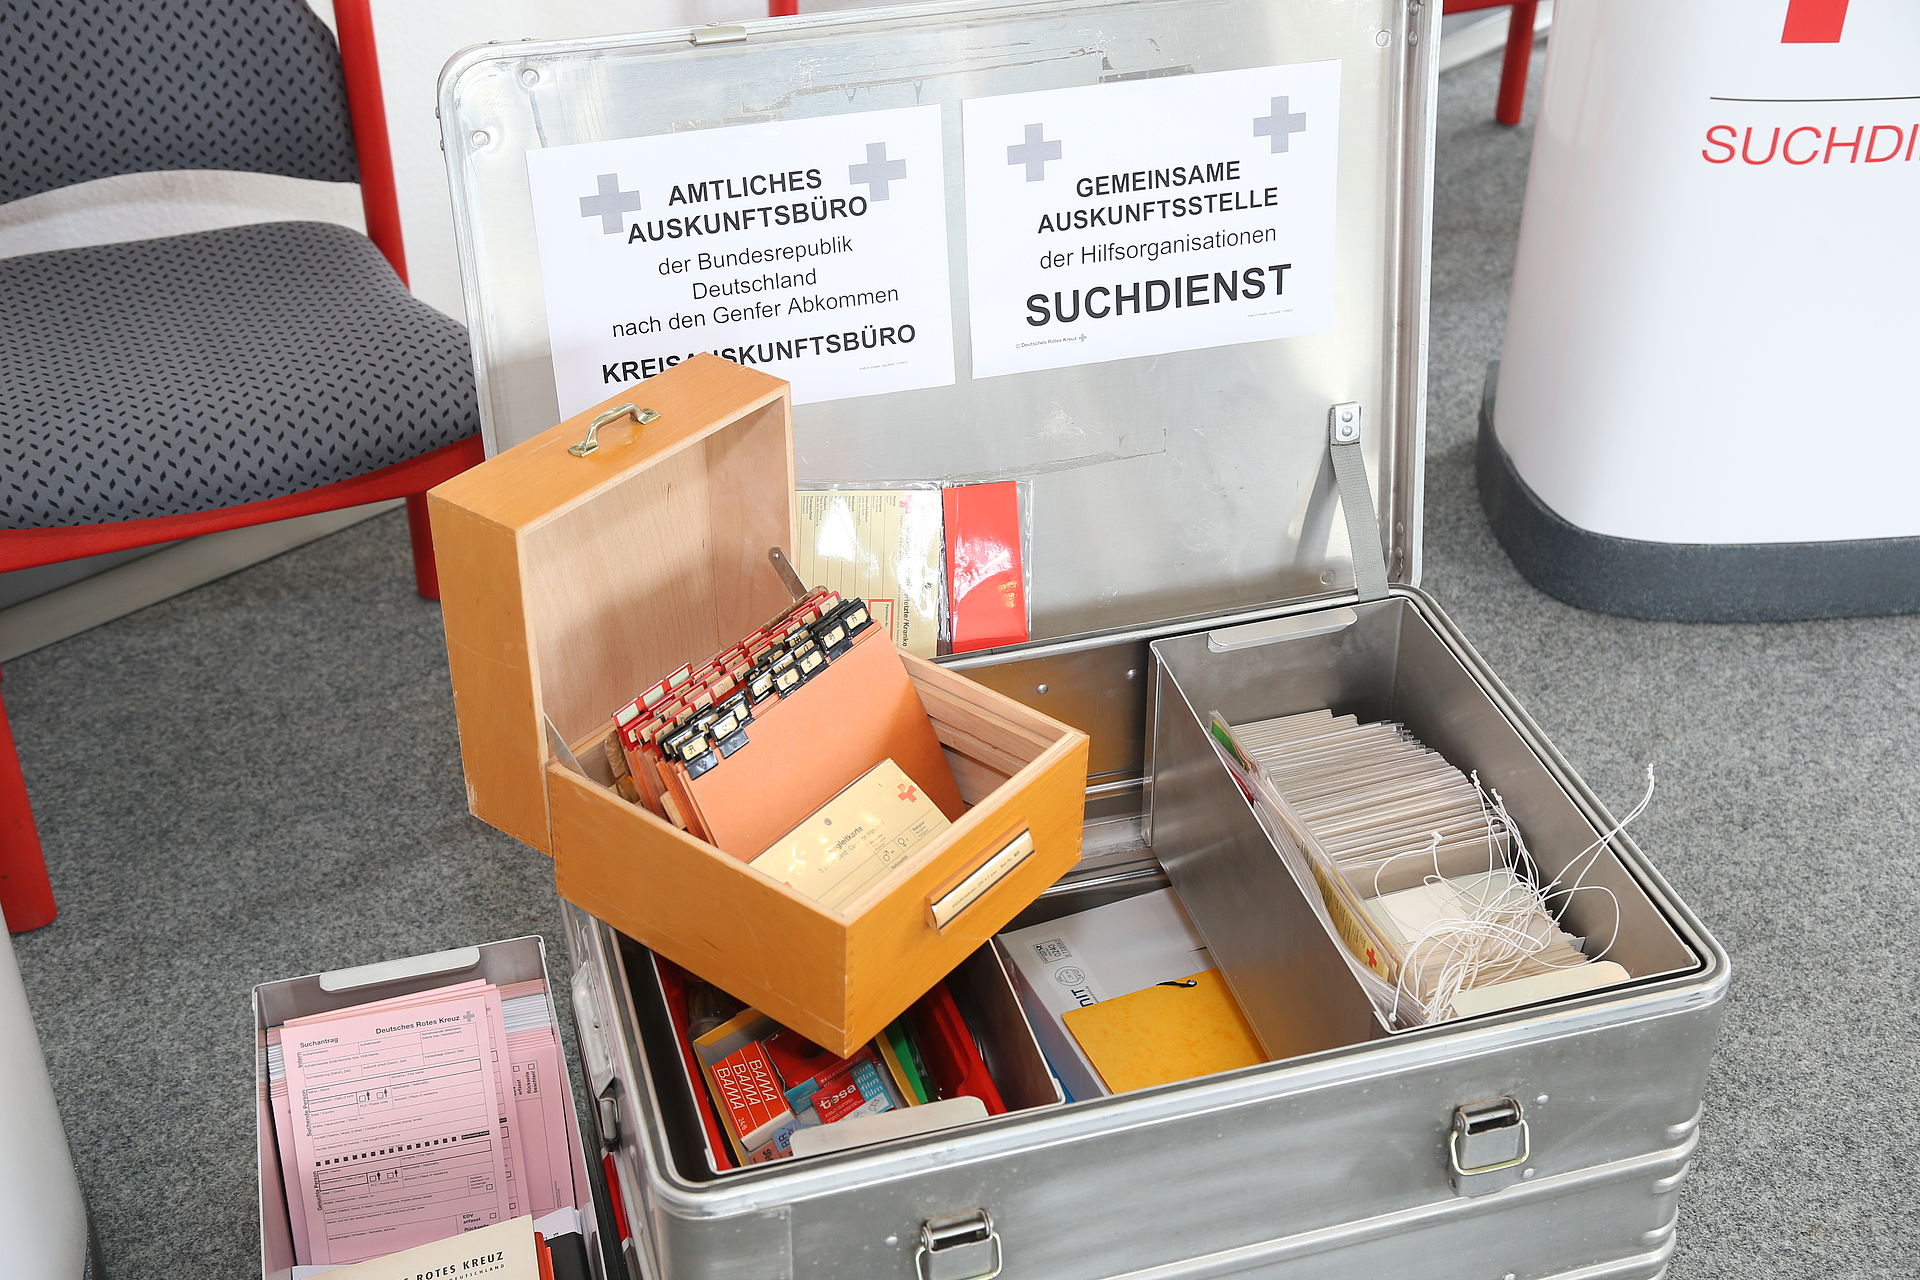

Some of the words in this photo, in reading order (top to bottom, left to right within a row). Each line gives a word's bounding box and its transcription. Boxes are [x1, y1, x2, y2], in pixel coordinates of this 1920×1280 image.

[1701, 123, 1920, 165] SUCHDI
[668, 168, 823, 207] AMTLICHES
[1075, 160, 1241, 198] GEMEINSAME
[627, 195, 868, 244] AUSKUNFTSBÜRO
[1037, 187, 1278, 234] AUSKUNFTSSTELLE
[658, 255, 691, 277] der
[698, 235, 854, 271] Bundesrepublik
[1039, 250, 1074, 270] der
[1081, 225, 1277, 266] Hilfsorganisationen
[692, 267, 818, 300] Deutschland
[1025, 263, 1292, 327] SUCHDIENST
[612, 314, 662, 338] nach
[668, 308, 706, 331] den
[713, 299, 781, 325] Genfer
[787, 285, 899, 315] Abkommen
[601, 323, 917, 384] KREISSKUNFTSBÜRO
[300, 1037, 339, 1048] Suchantrag
[375, 1023, 414, 1035] Deutsches
[416, 1019, 437, 1028] Rotes
[439, 1015, 460, 1024] Kreuz
[717, 1067, 745, 1110] BAMA
[733, 1063, 761, 1106] BAMA
[749, 1059, 778, 1102] BAMA
[853, 1063, 873, 1077] film
[857, 1071, 875, 1084] film
[861, 1078, 879, 1091] film
[819, 1084, 857, 1110] tesa
[865, 1085, 883, 1098] film
[304, 1110, 312, 1136] Suchende
[416, 1264, 456, 1280] ROTES
[462, 1251, 505, 1270] KREUZ
[448, 1263, 505, 1280] DEUTSCHLAND
